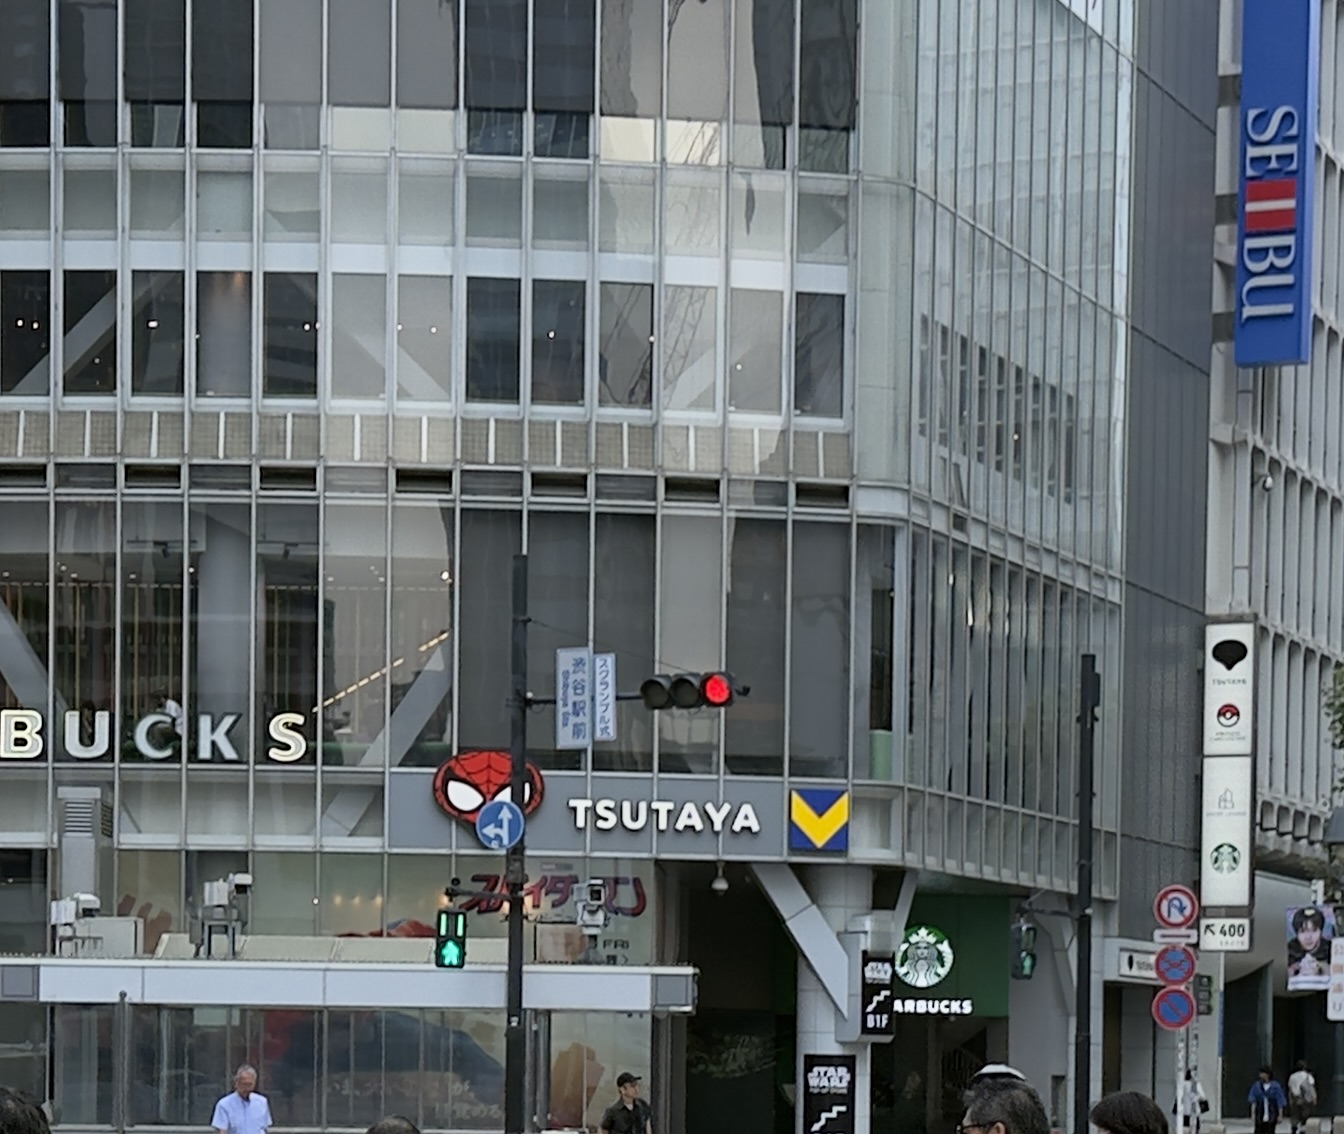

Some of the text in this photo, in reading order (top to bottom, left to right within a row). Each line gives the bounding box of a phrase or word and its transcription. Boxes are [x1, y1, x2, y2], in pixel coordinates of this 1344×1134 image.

[571, 657, 587, 740] 渋谷駅前
[599, 659, 611, 737] スクランブル式
[568, 798, 761, 833] TSUTAYA
[1219, 924, 1246, 938] 400
[893, 999, 973, 1015] ARBUCKS
[866, 1013, 889, 1028] B1F
